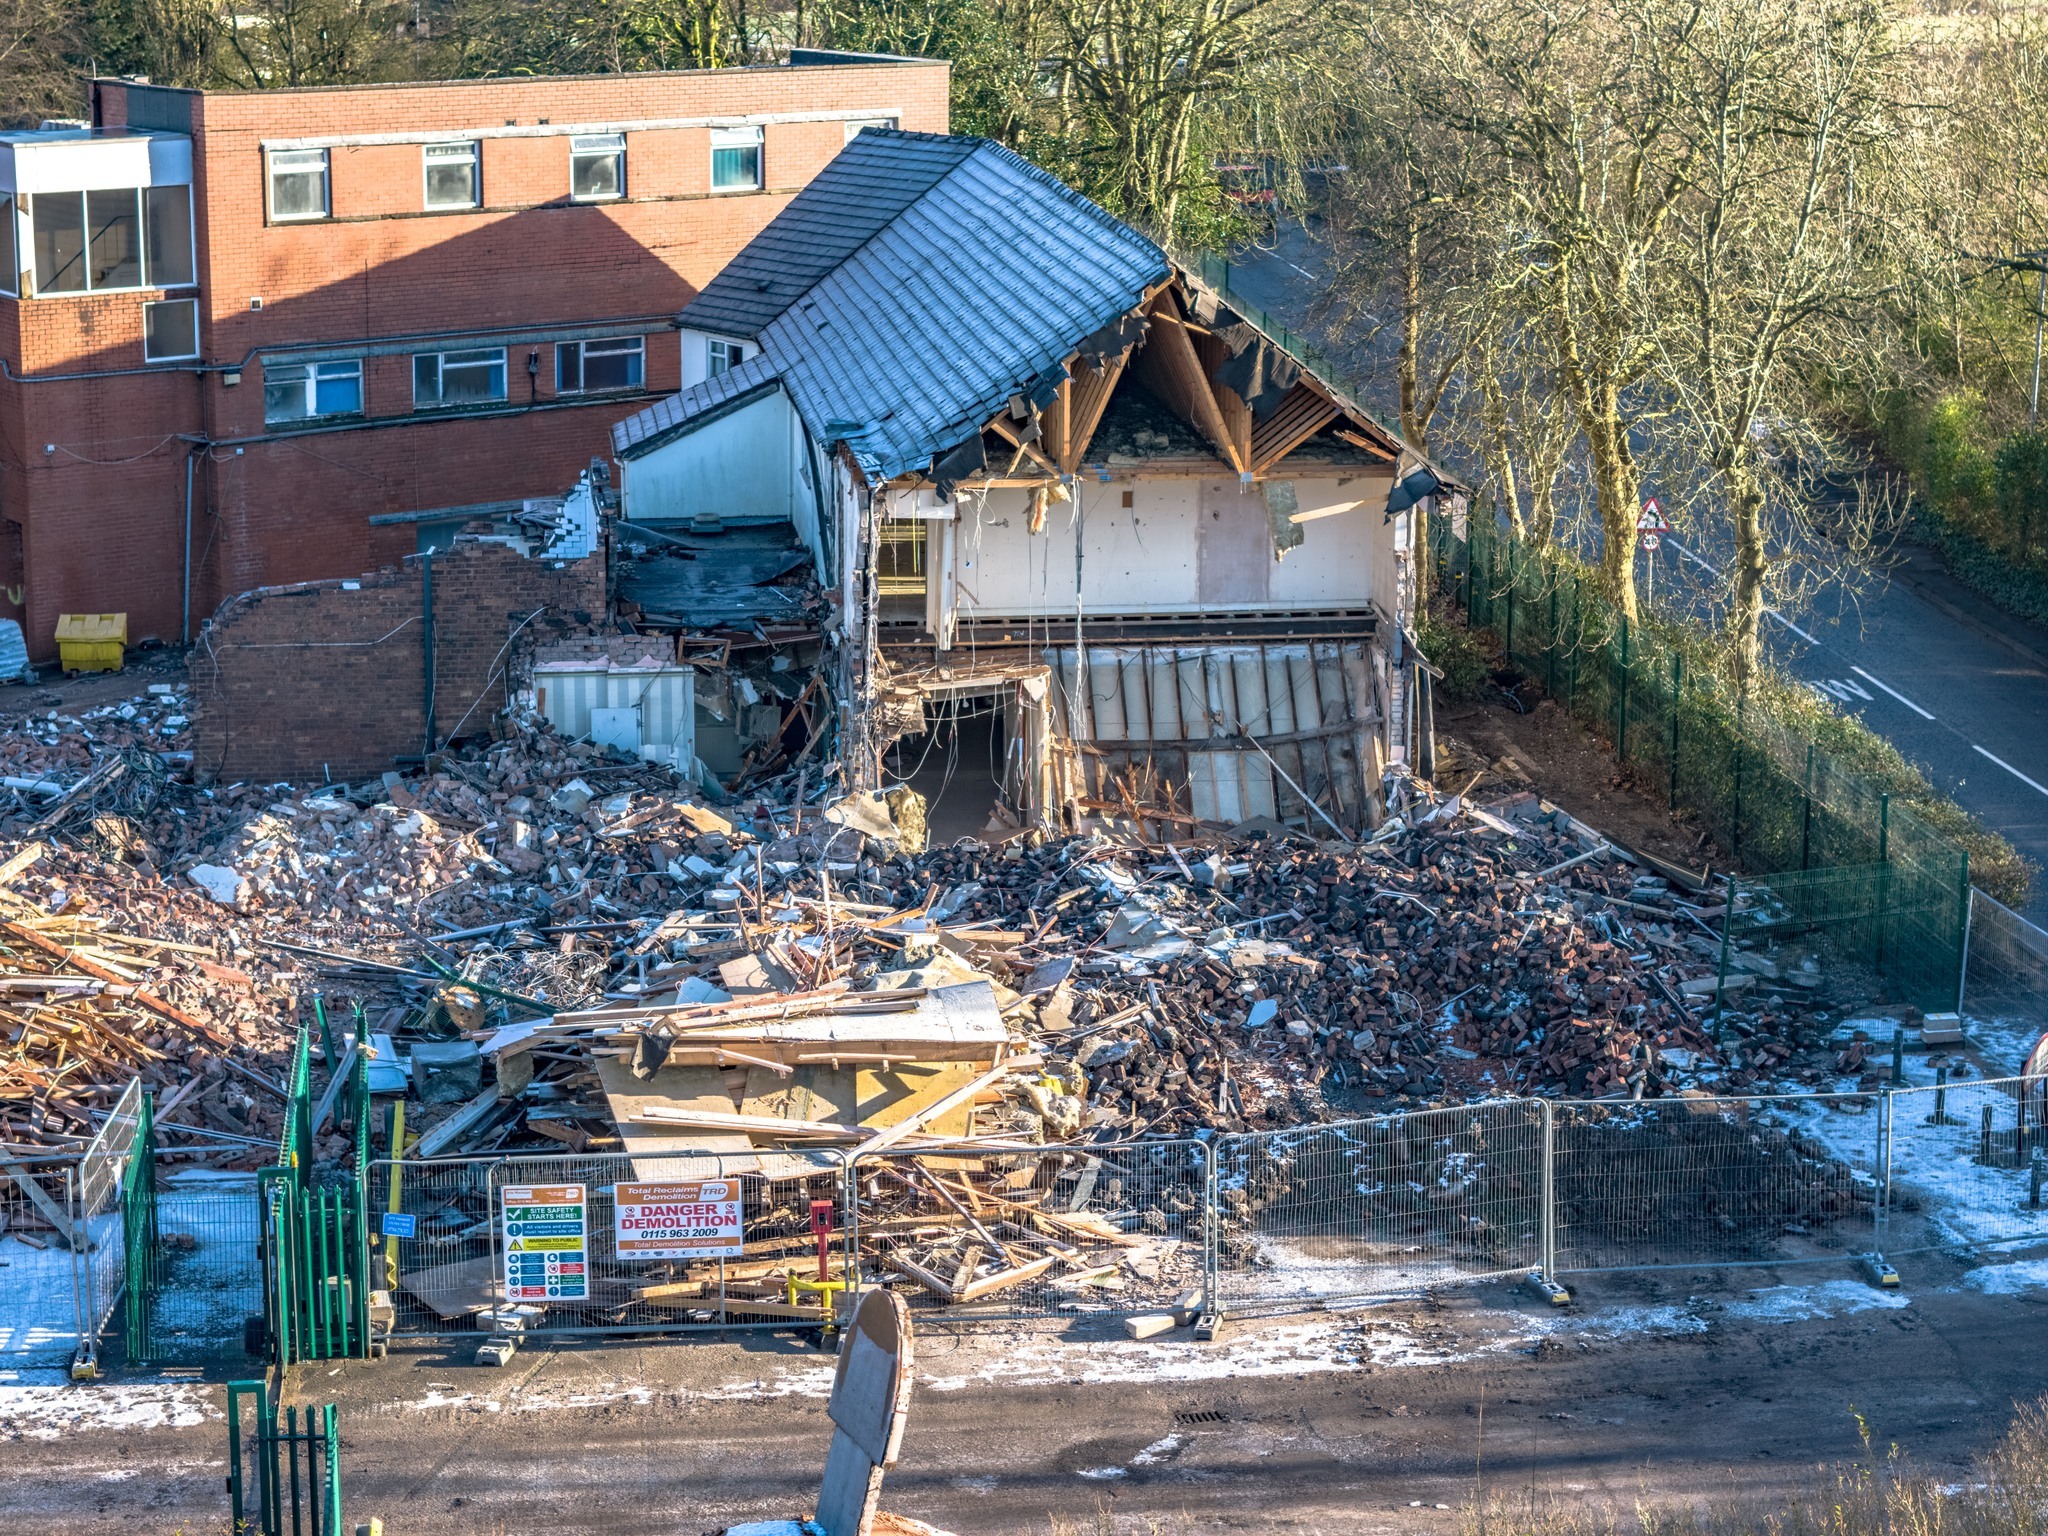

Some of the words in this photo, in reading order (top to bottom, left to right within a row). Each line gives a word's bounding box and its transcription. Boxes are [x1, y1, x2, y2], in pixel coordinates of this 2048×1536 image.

[627, 1187, 651, 1195] Total
[653, 1186, 699, 1194] Reclaims
[643, 1193, 697, 1201] Demolition
[640, 1204, 718, 1217] DANGER
[621, 1215, 737, 1230] DEMOLITION
[641, 1230, 667, 1239] 0115
[669, 1229, 689, 1238] 963
[692, 1228, 718, 1237] 2009
[652, 1240, 691, 1248] Demolition
[693, 1239, 726, 1247] Solutions
